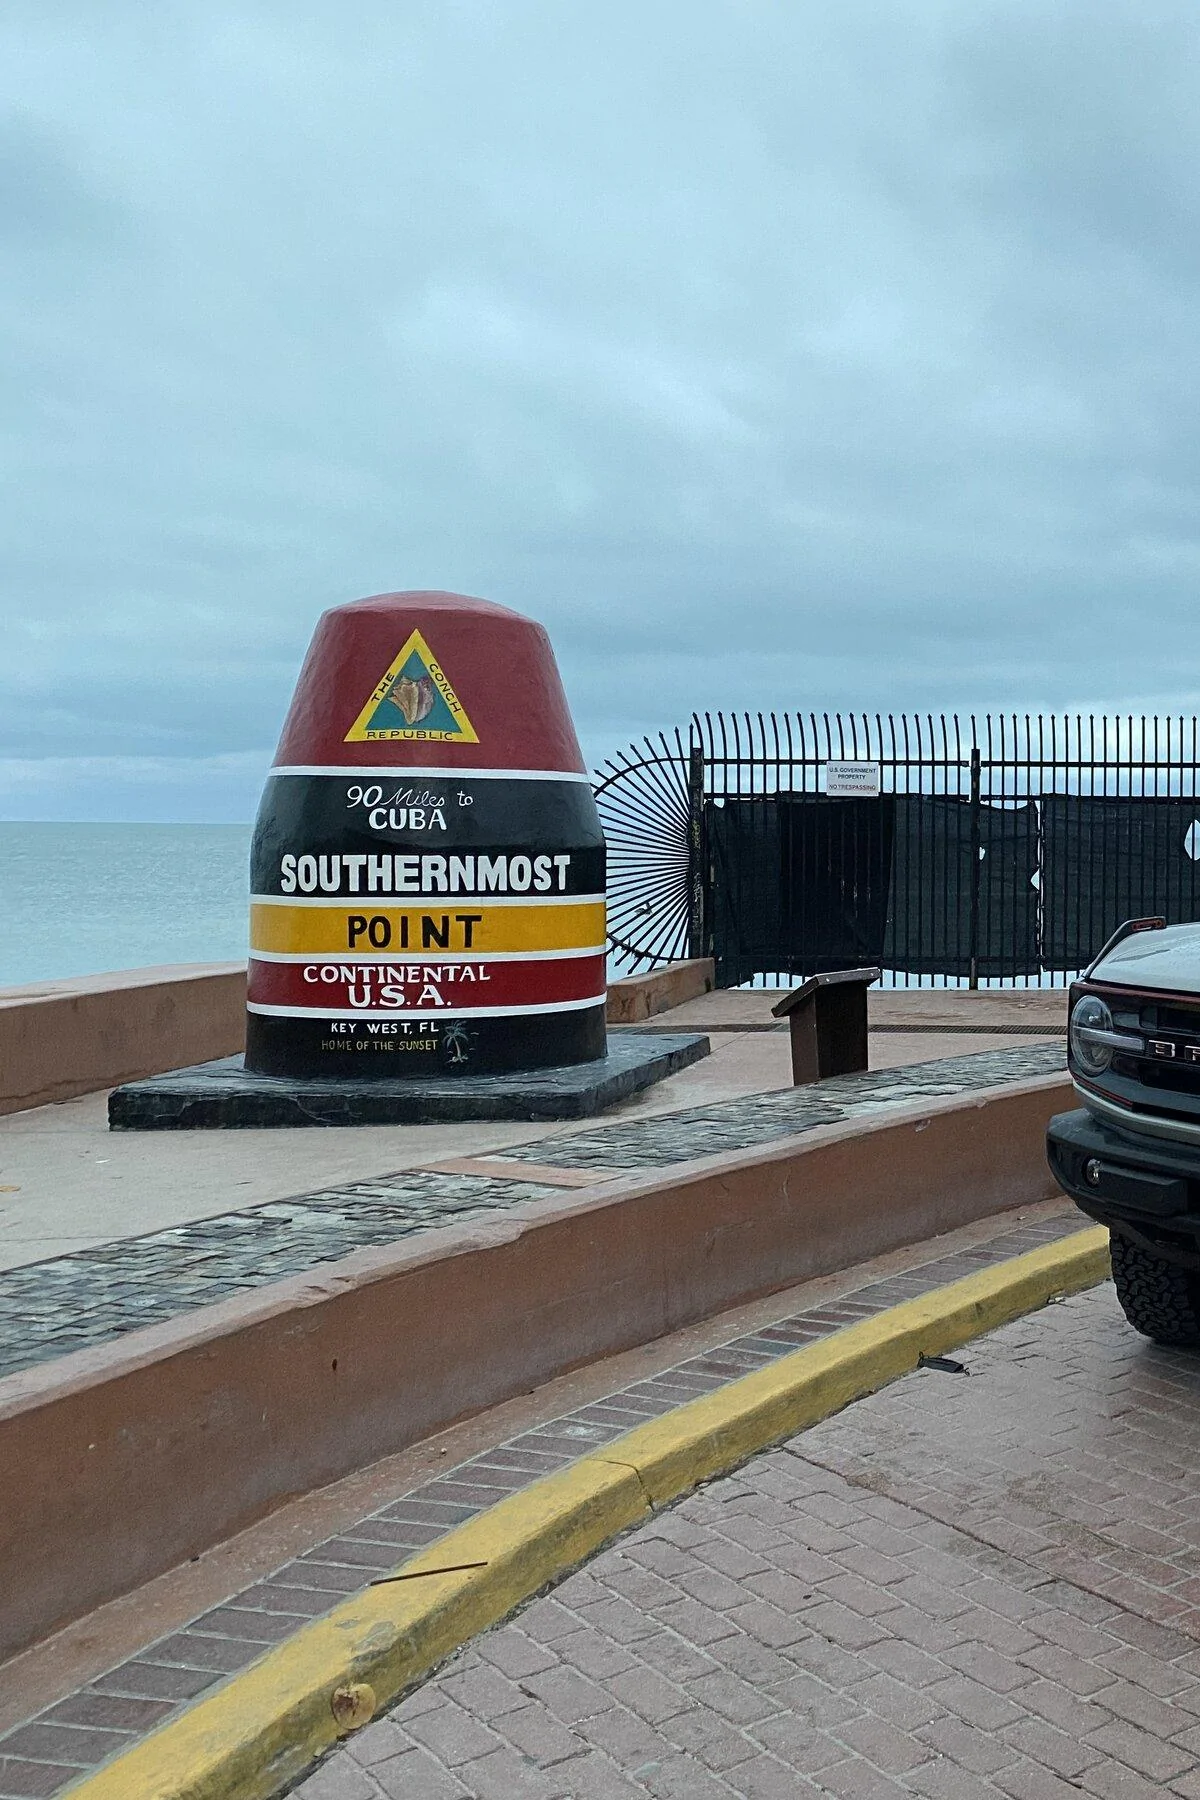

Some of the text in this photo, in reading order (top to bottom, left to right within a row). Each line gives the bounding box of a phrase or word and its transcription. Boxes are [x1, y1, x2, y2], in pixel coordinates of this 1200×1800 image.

[371, 672, 395, 703] THE
[429, 663, 461, 713] CONCH
[366, 730, 453, 740] REPUBLIC
[346, 785, 474, 808] 90 Miles to
[368, 808, 448, 831] CUBA
[280, 854, 571, 893] SOUTHERNMOST
[347, 914, 483, 949] POINT
[303, 965, 491, 984] CONTINENTAL
[348, 984, 452, 1008] U.S.A.
[331, 1021, 440, 1035] KEY WEST, FL
[321, 1039, 438, 1051] HOME OF THE SUNSET
